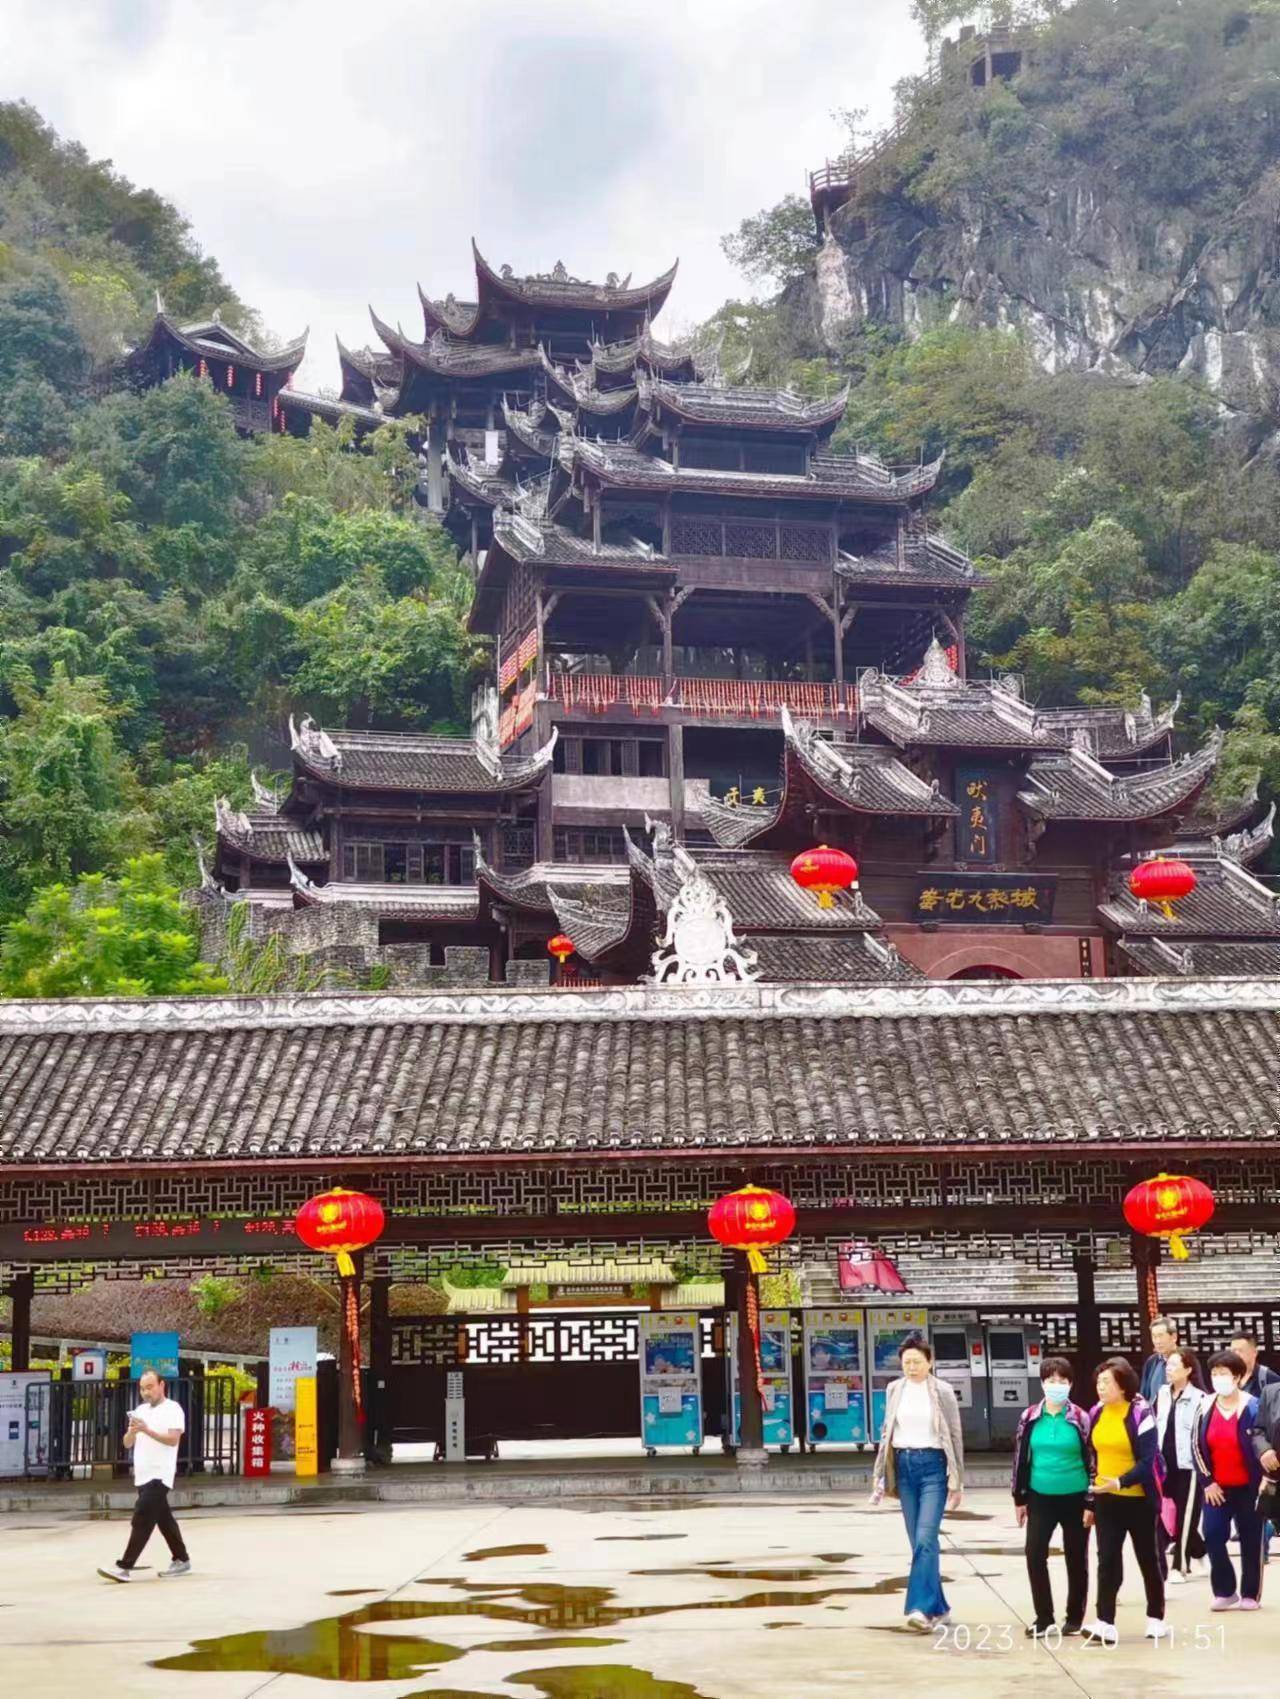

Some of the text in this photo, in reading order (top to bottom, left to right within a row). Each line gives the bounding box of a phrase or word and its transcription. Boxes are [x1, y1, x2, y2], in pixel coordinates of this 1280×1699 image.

[919, 886, 1041, 912] 蚩尤九黎城
[251, 1411, 265, 1468] 火种收集箱
